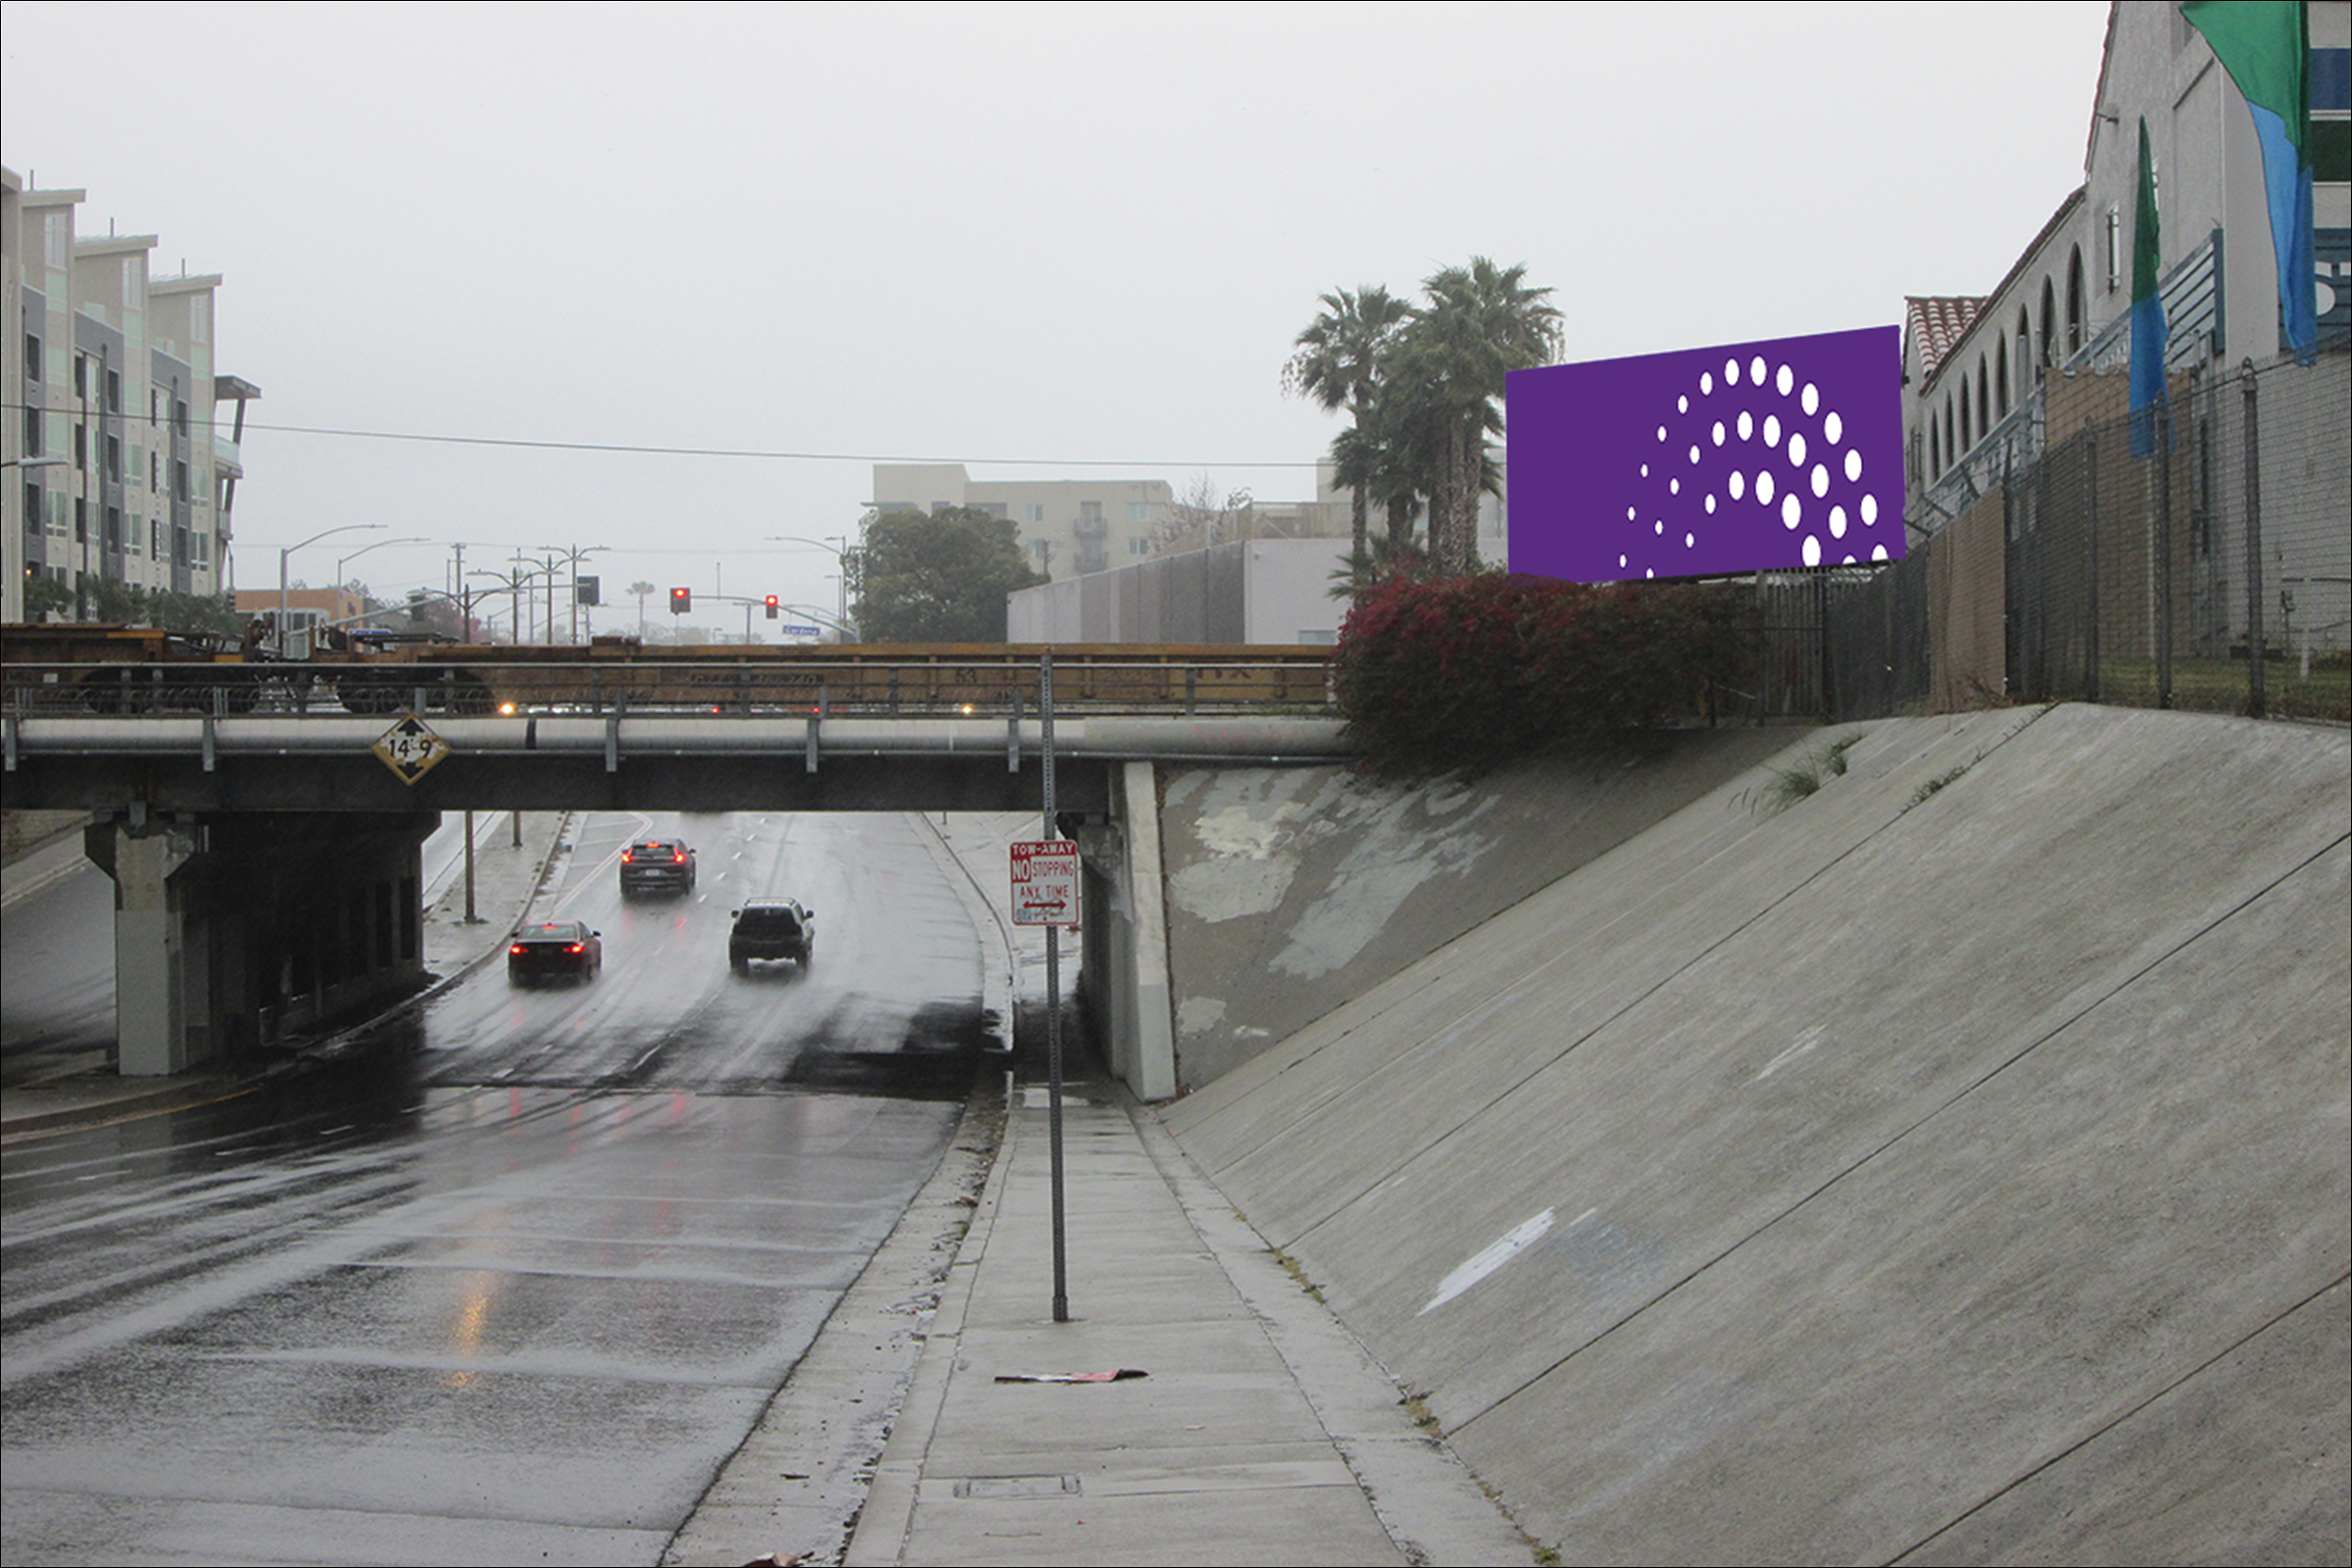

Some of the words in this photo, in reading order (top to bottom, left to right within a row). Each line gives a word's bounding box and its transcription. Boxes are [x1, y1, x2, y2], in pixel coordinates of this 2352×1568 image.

[1012, 844, 1073, 856] TOW-AWAY
[1012, 859, 1030, 880] NO
[1032, 860, 1074, 877] STOPPING
[1020, 885, 1040, 899] ANY
[1046, 884, 1069, 899] TIME
